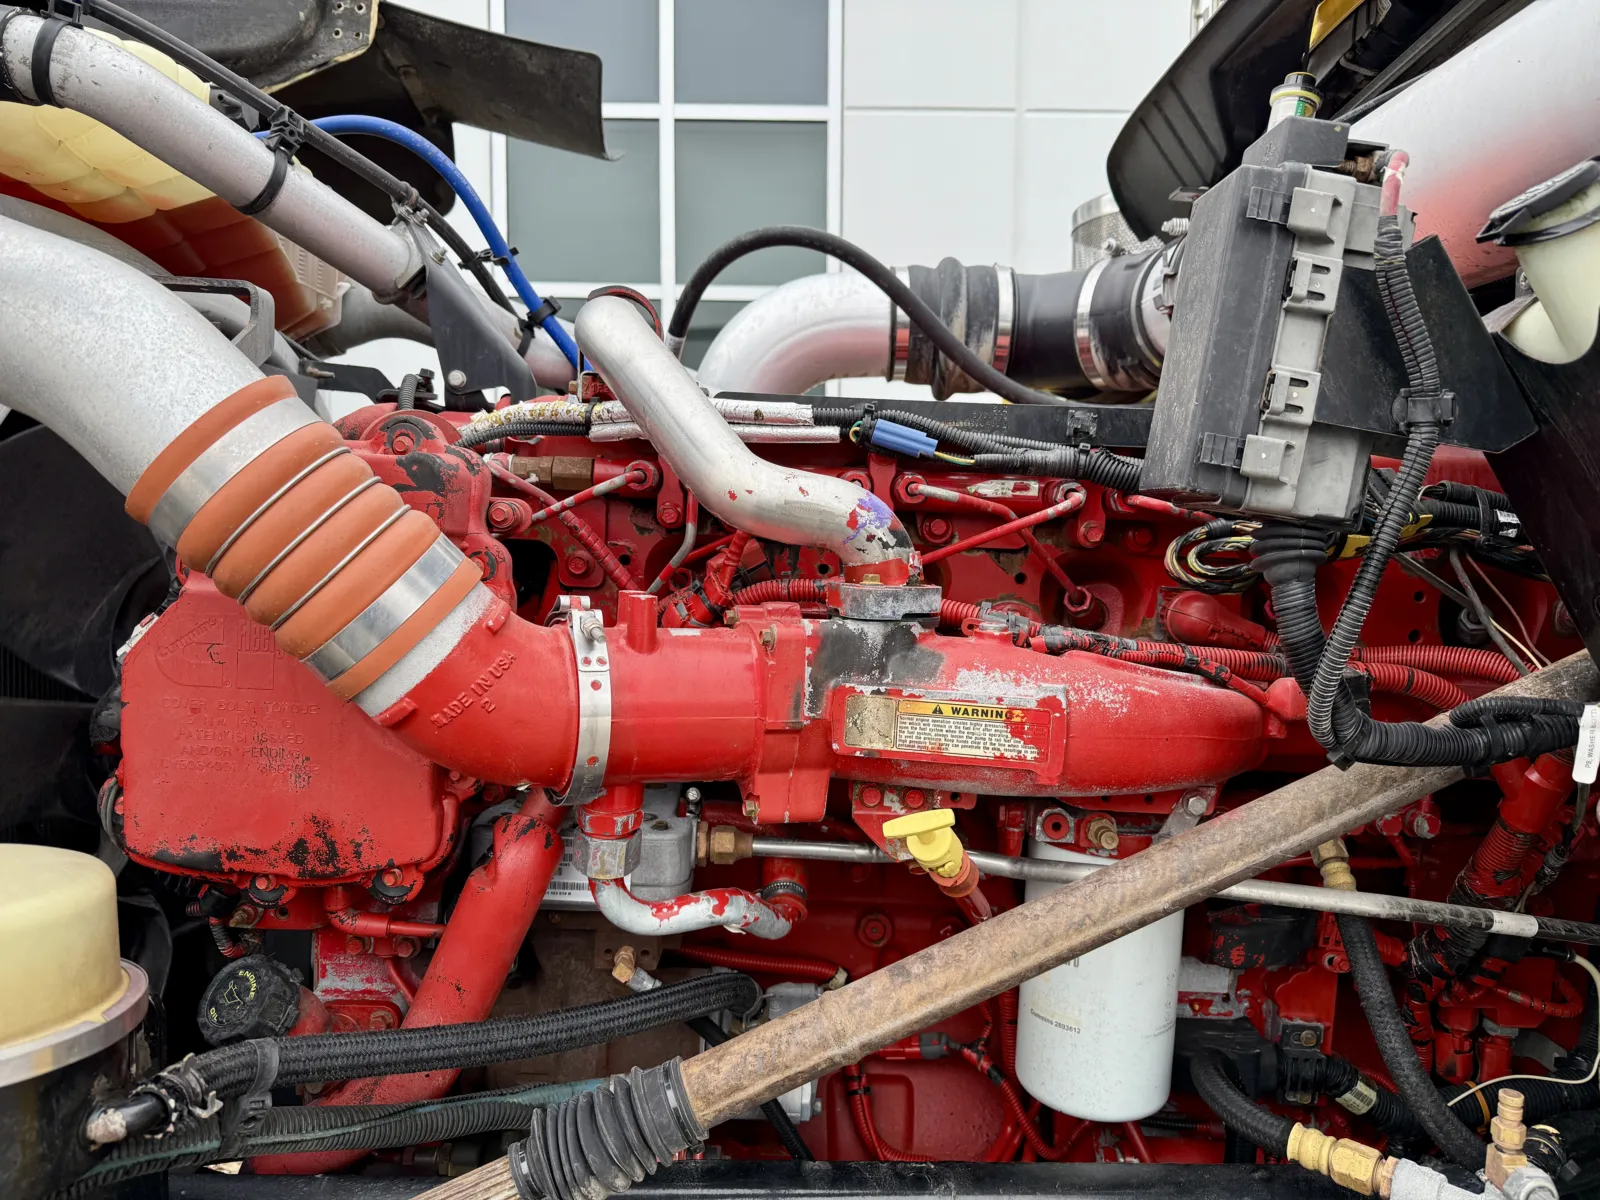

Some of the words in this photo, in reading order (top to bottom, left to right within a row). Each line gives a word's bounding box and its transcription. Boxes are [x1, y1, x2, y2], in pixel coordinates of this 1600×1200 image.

[430, 692, 474, 728] MADE
[470, 675, 494, 697] IN
[488, 650, 517, 679] USA
[480, 697, 496, 713] 2
[951, 707, 1013, 719] WARNING
[257, 732, 304, 744] ISSUED
[1588, 730, 1596, 758] WASHER
[239, 970, 257, 1000] ENGINE
[210, 1007, 218, 1022] OIL
[1030, 1008, 1053, 1026] Cummins
